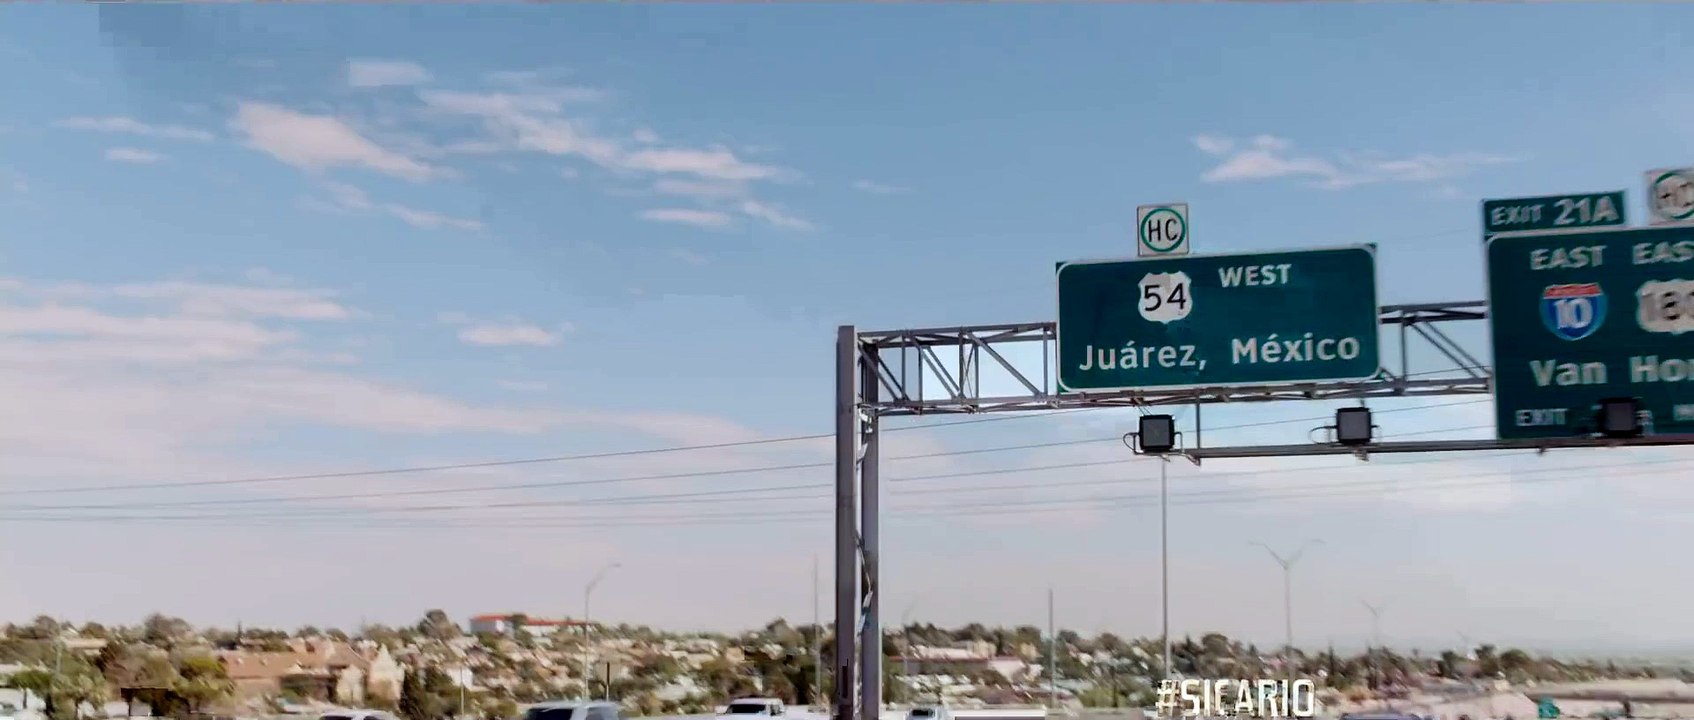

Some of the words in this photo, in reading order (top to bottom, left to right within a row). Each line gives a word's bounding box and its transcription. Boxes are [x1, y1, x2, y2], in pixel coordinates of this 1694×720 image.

[1491, 204, 1544, 226] EXIT
[1553, 196, 1619, 225] 21A
[1147, 218, 1178, 242] HC
[1530, 245, 1607, 270] EAST
[1218, 264, 1291, 288] WEST
[1143, 283, 1187, 312] 54
[1553, 298, 1593, 329] 10
[1079, 340, 1206, 371] Juárez,
[1231, 332, 1360, 365] México
[1530, 360, 1608, 386] Van
